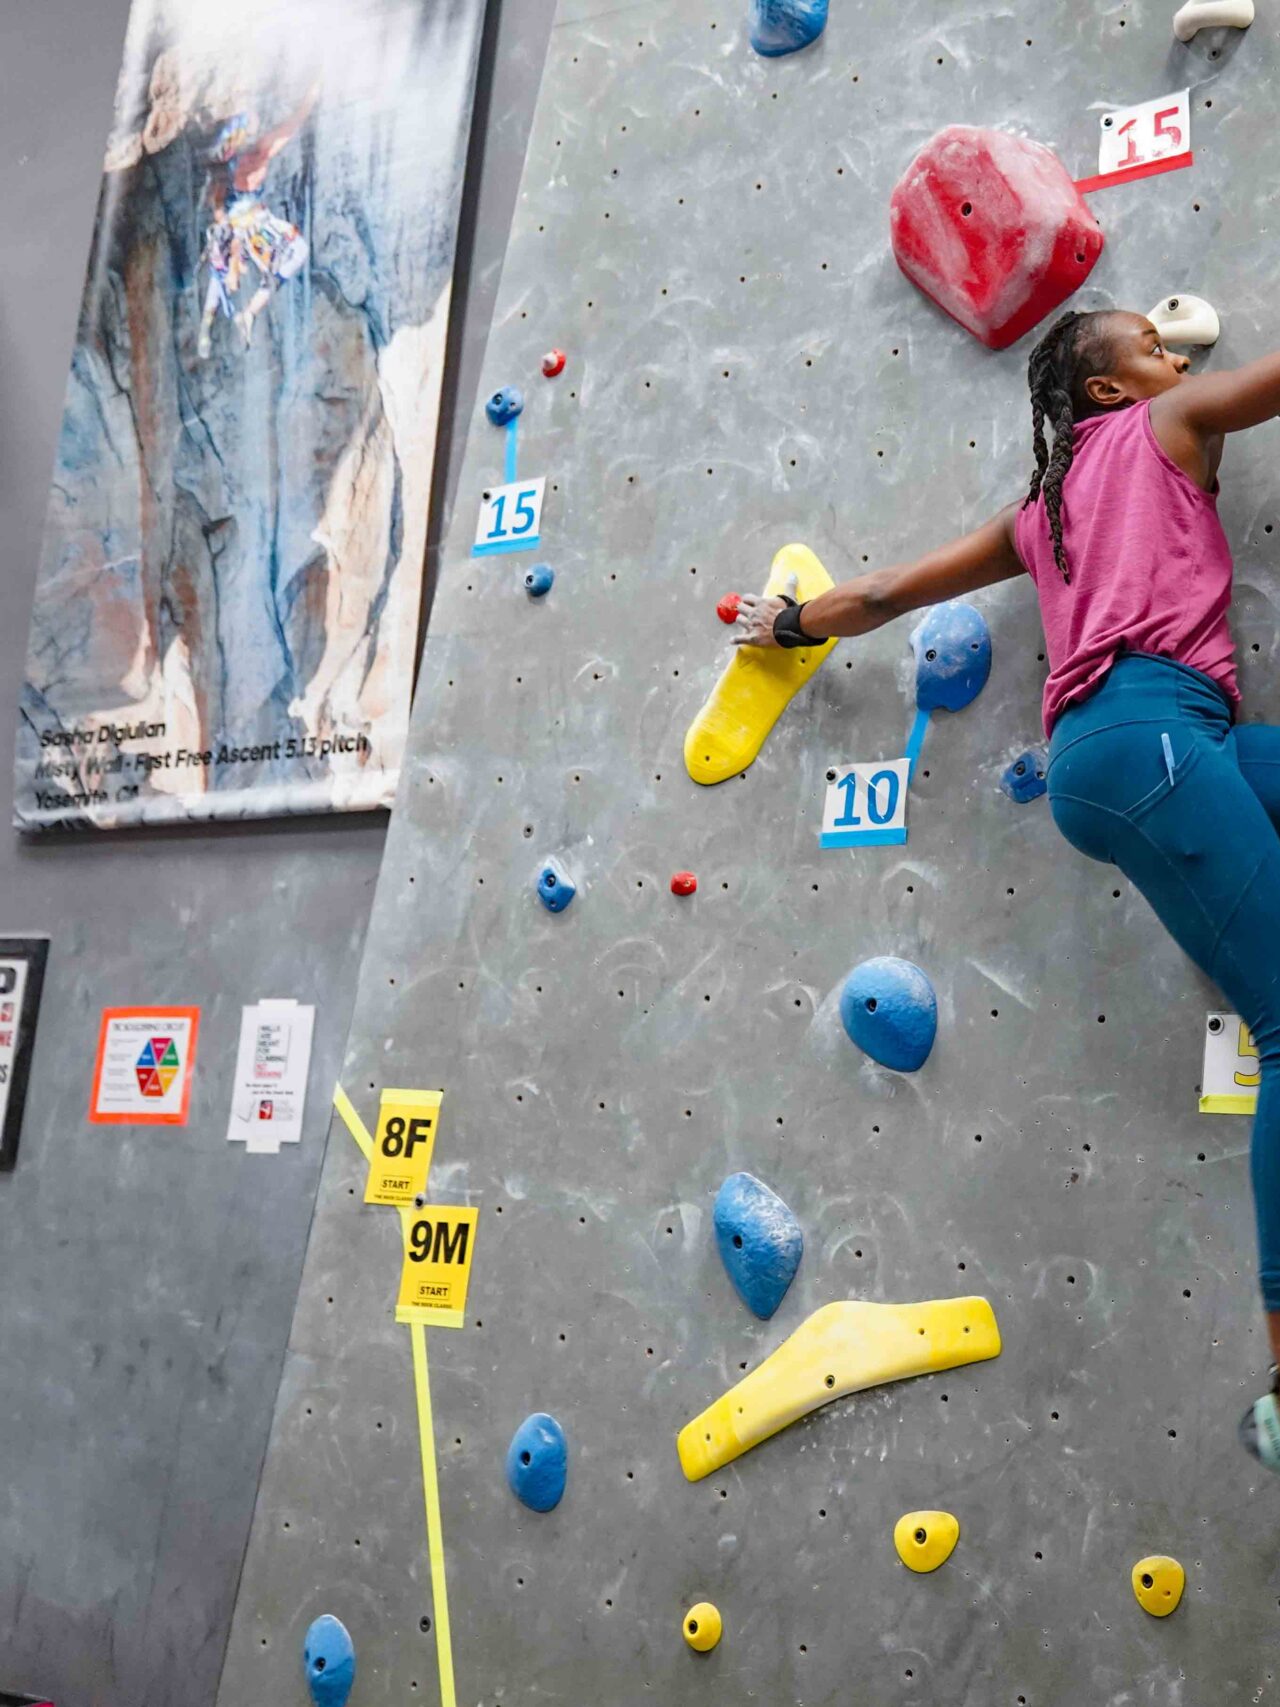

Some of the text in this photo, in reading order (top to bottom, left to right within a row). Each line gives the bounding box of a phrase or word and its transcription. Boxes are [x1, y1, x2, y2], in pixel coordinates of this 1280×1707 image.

[1117, 106, 1182, 168] 15
[487, 489, 537, 539] 15
[41, 727, 94, 748] Sasha
[133, 751, 172, 772] First
[174, 748, 213, 770] Free
[215, 740, 282, 765] Ascent
[284, 738, 316, 760] 5.13
[319, 732, 369, 761] pitch
[833, 769, 900, 827] 10
[1233, 1021, 1262, 1087] 5
[381, 1117, 432, 1158] 8F
[382, 1179, 411, 1190] START
[408, 1220, 470, 1265] 9M
[419, 1286, 449, 1297] START
